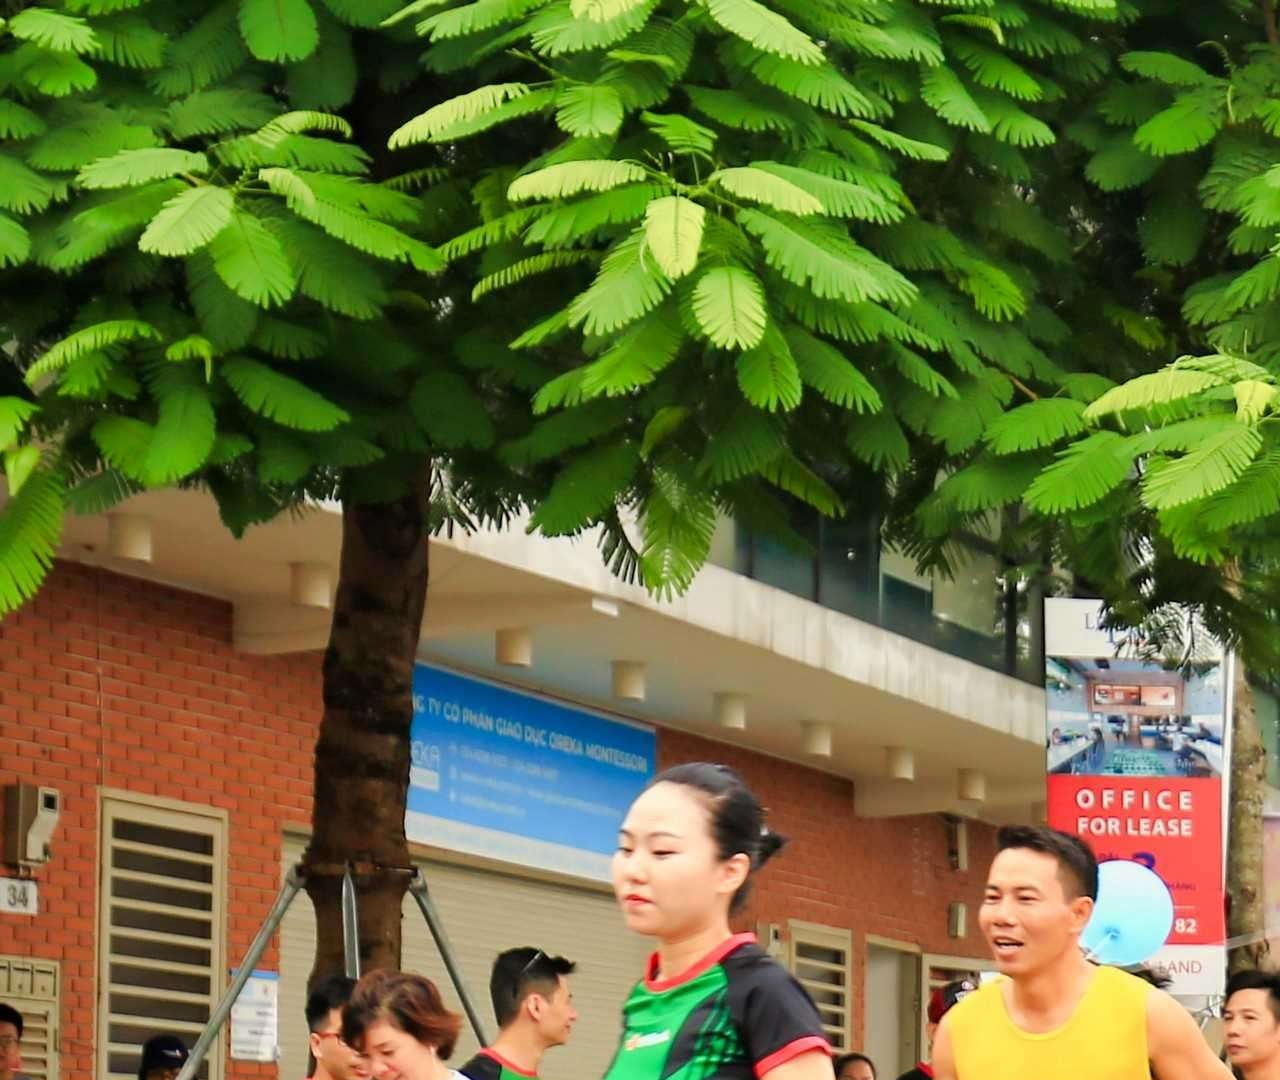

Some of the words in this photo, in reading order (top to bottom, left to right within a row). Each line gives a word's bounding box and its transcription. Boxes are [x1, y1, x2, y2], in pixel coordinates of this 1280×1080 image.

[1076, 788, 1193, 811] OFFICE
[1077, 816, 1121, 836] FOR
[1127, 818, 1193, 838] LEASE
[7, 883, 29, 907] 34
